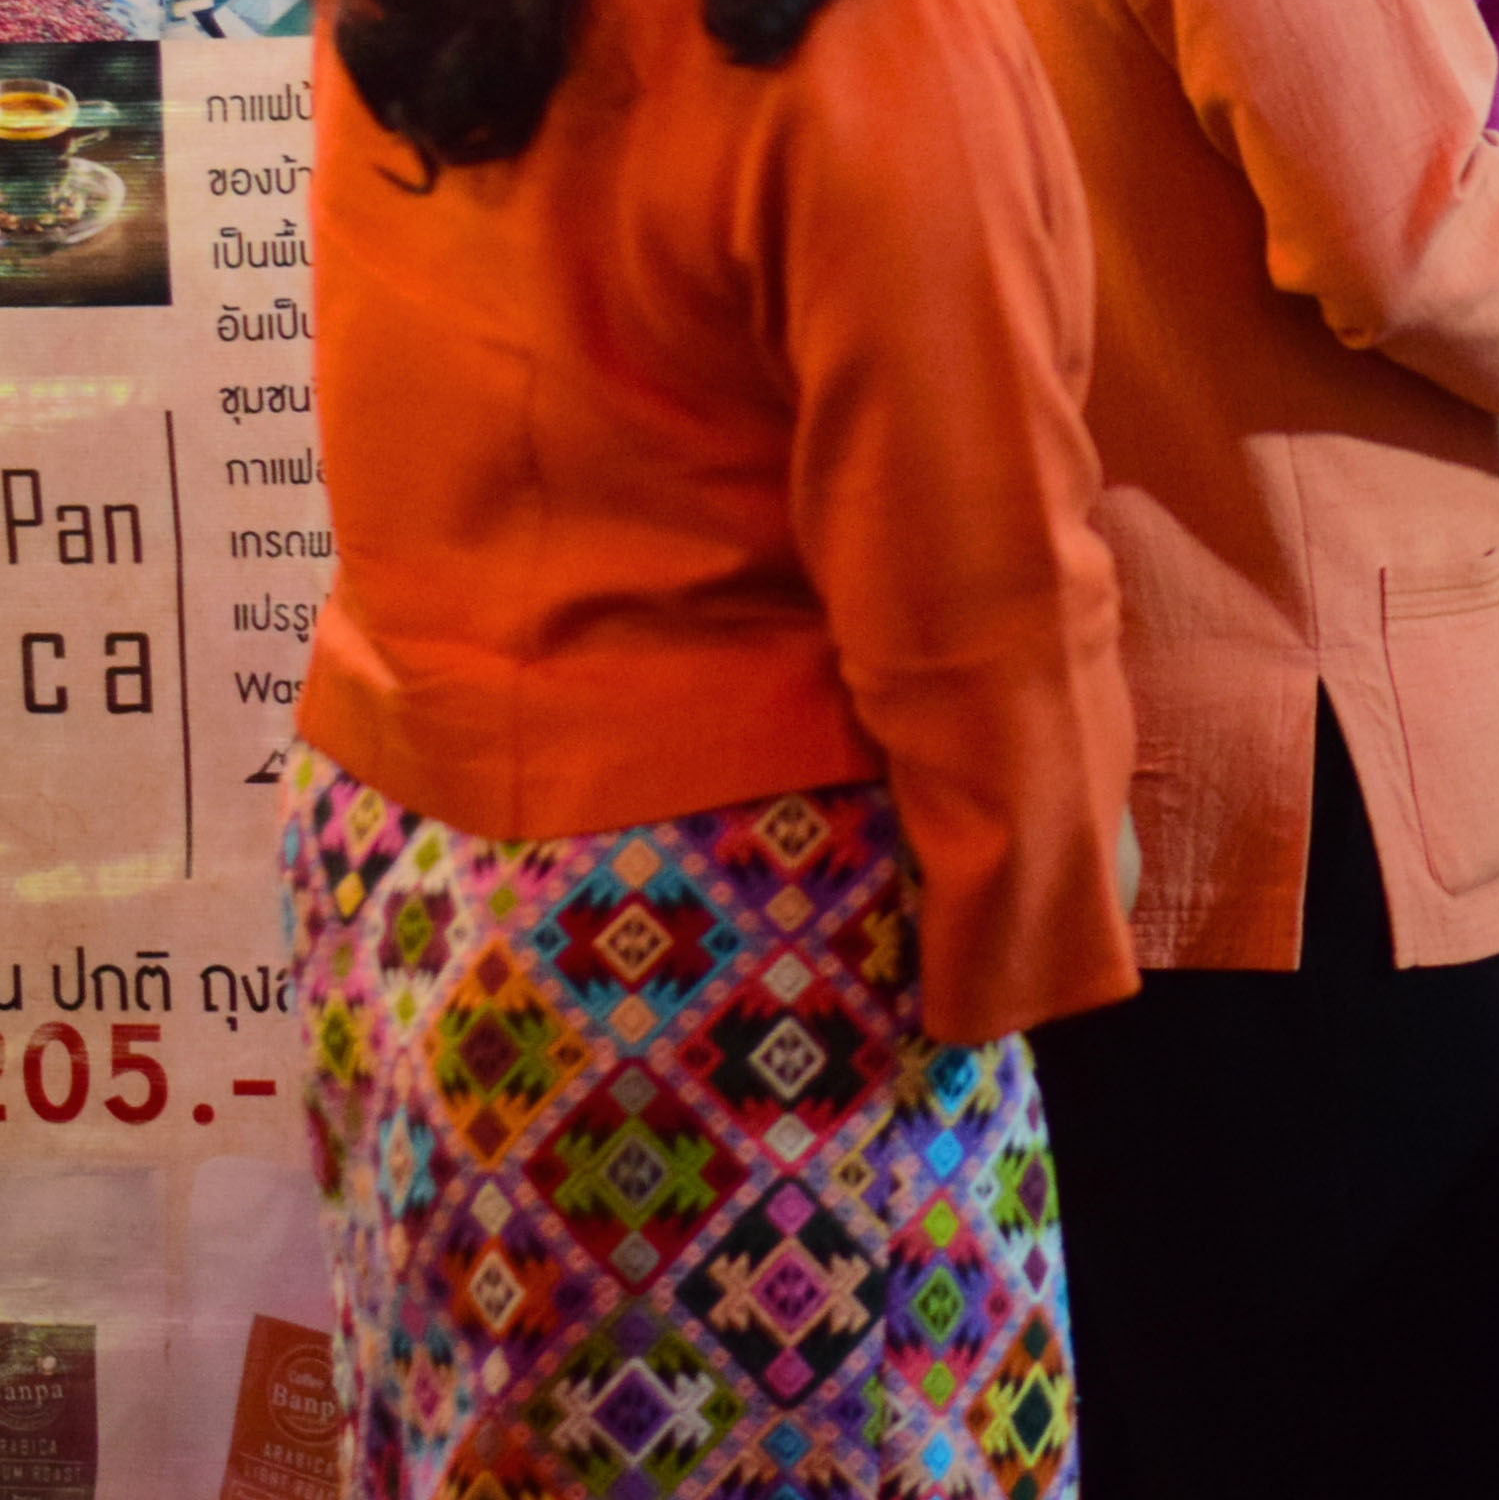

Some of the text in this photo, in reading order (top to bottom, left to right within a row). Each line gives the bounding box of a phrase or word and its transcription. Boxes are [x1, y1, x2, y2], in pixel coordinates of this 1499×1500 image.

[2, 468, 142, 565] Pan
[52, 945, 171, 1012] ปกติ
[0, 1021, 276, 1126] 05.-
